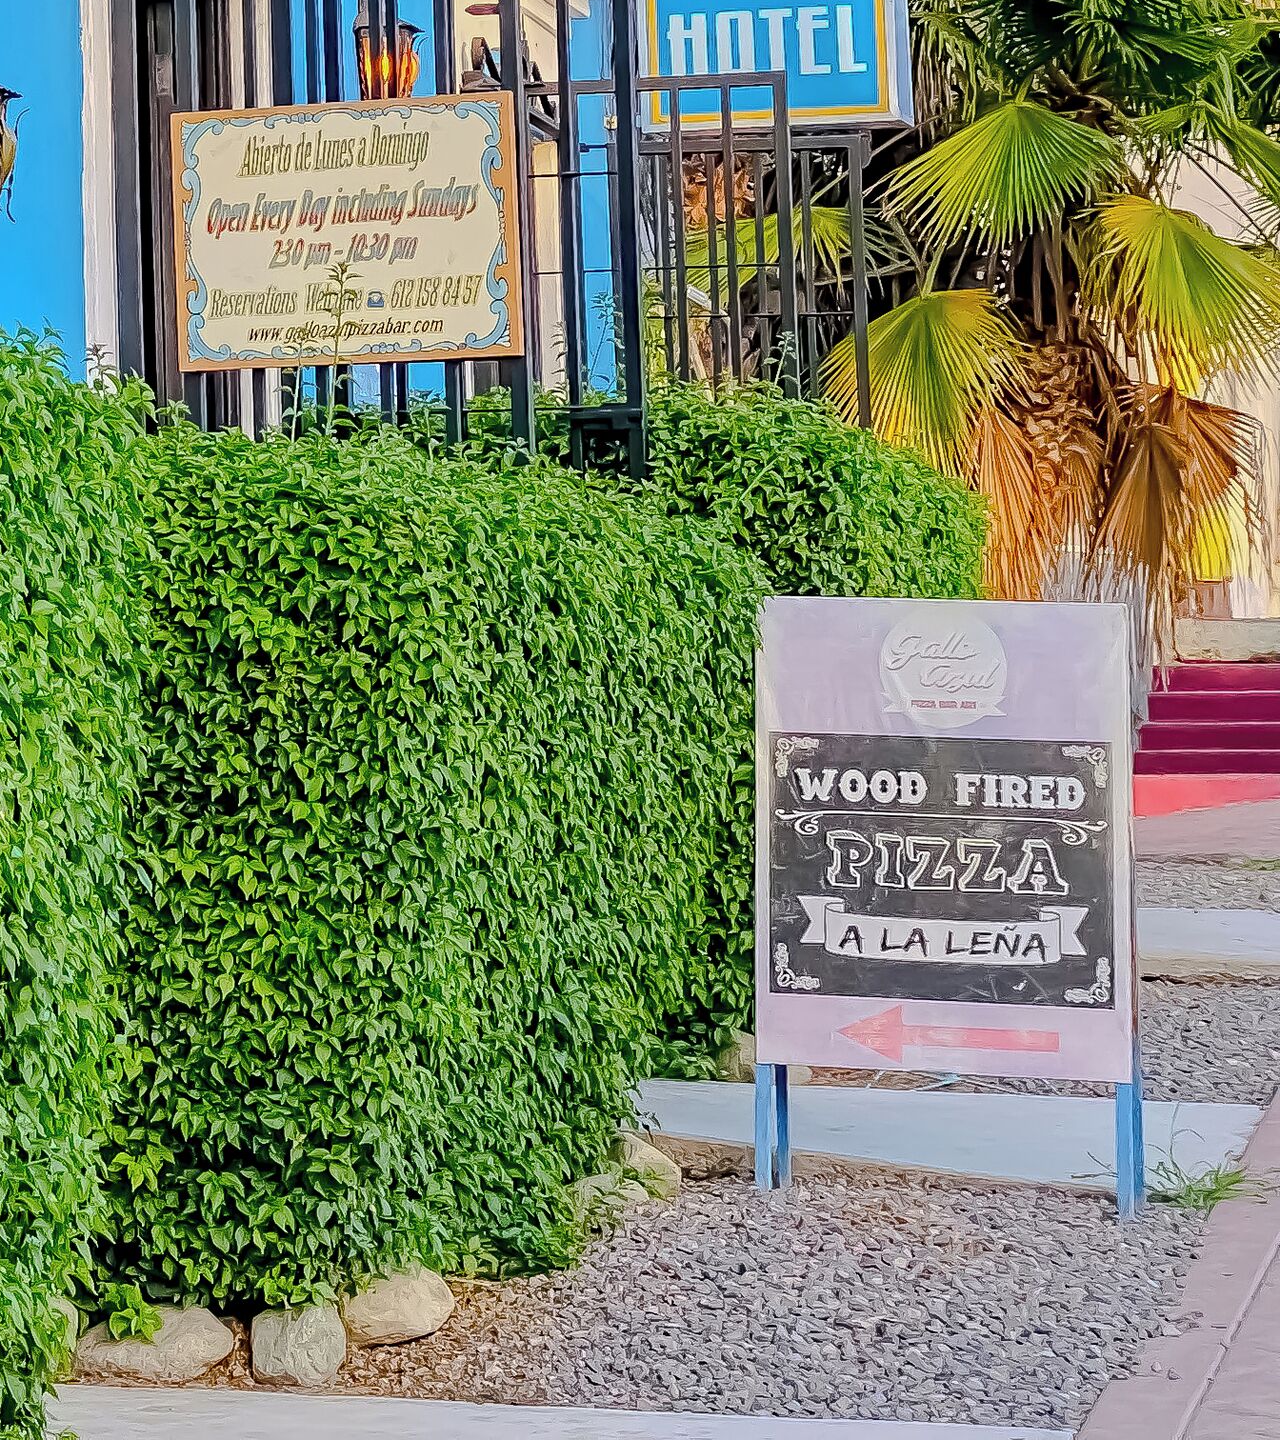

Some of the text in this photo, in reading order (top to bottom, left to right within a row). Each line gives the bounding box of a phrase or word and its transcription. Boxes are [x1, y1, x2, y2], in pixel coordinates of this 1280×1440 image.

[666, 4, 867, 75] HOTEL
[239, 122, 429, 176] Abierto de Lunes a Domingo
[207, 177, 480, 239] Open Every Day including Sundays
[210, 287, 297, 318] Reservations
[392, 279, 414, 308] 612
[415, 277, 439, 307] 158
[442, 276, 461, 306] 84
[462, 274, 482, 305] 57
[794, 768, 1086, 811] WOOD FIRED
[826, 830, 1069, 896] PIZZA
[839, 925, 1048, 962] A LA LEÑA
